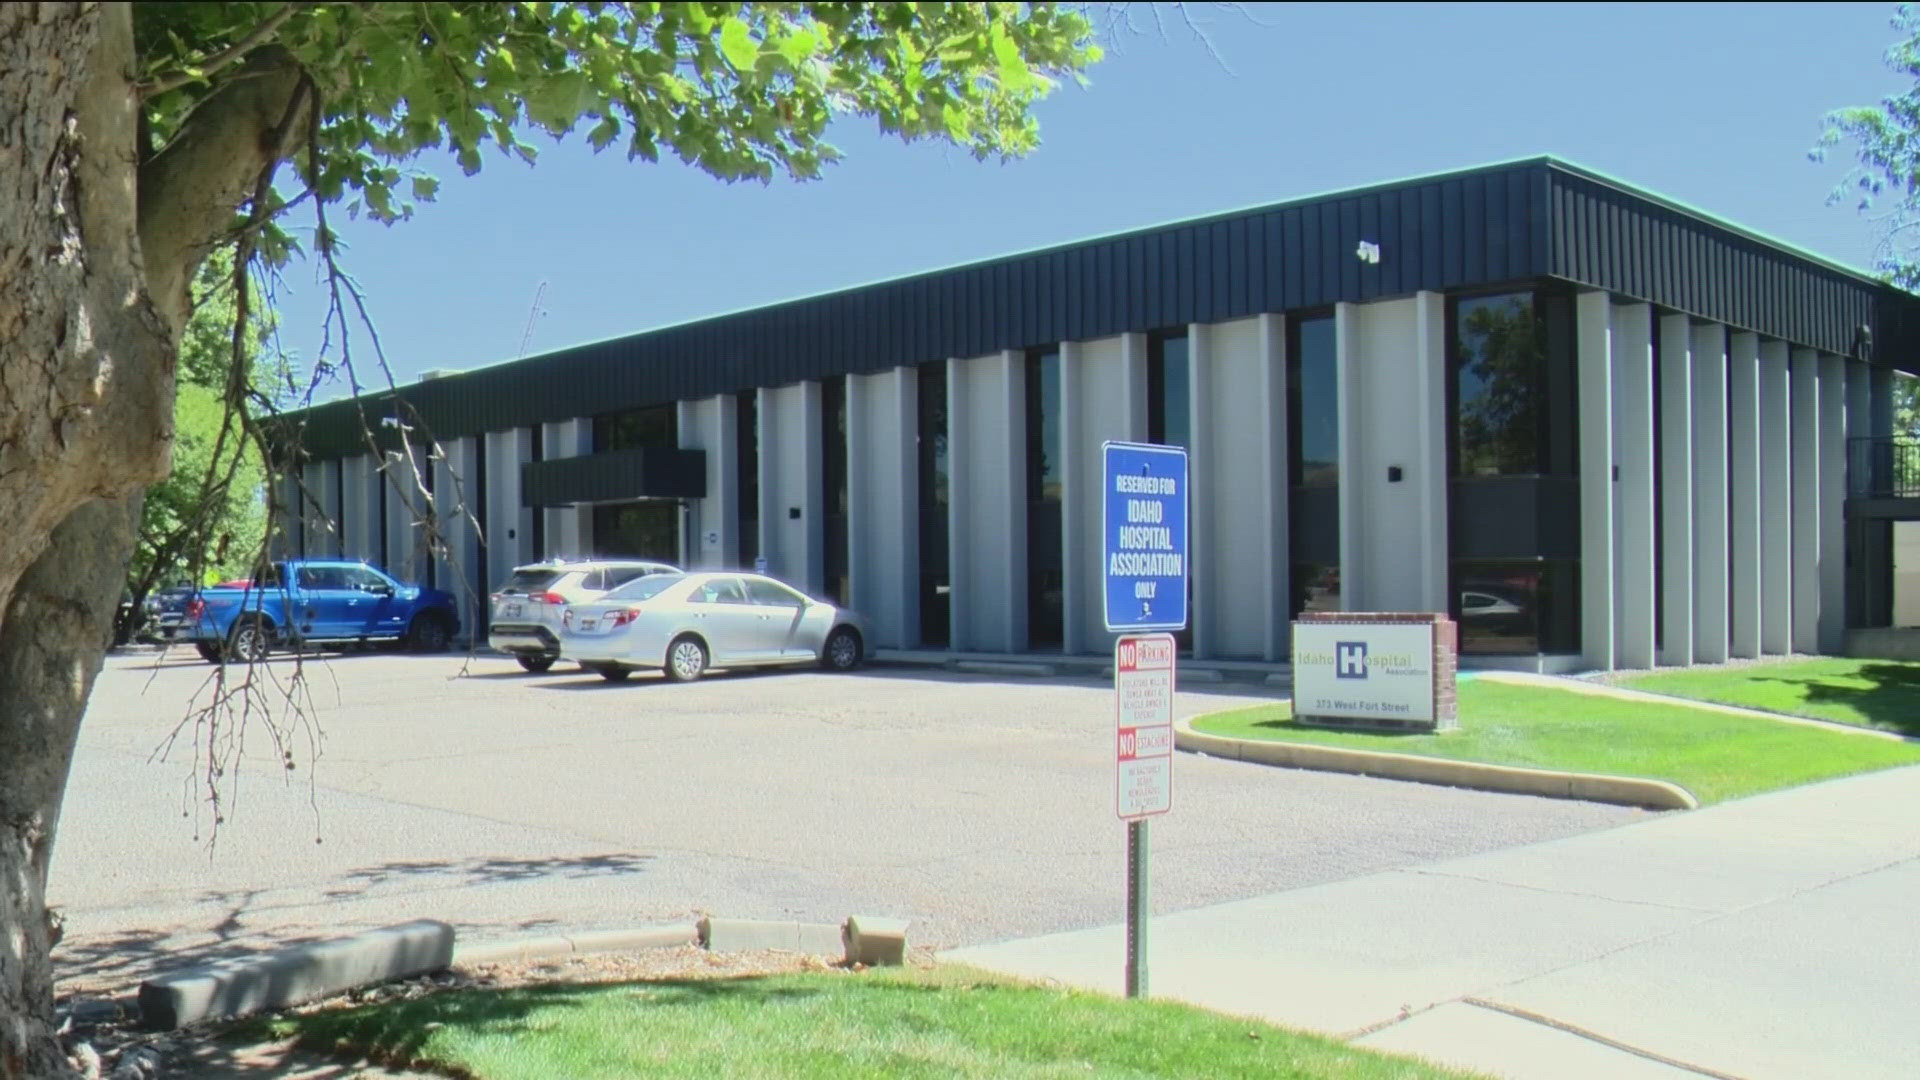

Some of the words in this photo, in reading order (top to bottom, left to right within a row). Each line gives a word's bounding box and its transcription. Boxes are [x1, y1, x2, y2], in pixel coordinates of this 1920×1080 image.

[1116, 475, 1158, 494] RESERVED
[1159, 478, 1176, 495] FOR
[1127, 499, 1163, 523] IDAHO
[1120, 526, 1173, 550] HOSPITAL
[1110, 552, 1182, 576] ASSOCIATION
[1134, 581, 1157, 599] ONLY
[1120, 644, 1135, 667] NO
[1298, 652, 1335, 666] Idaho
[1385, 668, 1428, 676] Association
[1315, 699, 1331, 710] 373
[1334, 700, 1357, 710] West
[1359, 701, 1379, 711] Fort
[1381, 702, 1410, 713] Street
[1120, 733, 1135, 756] NO
